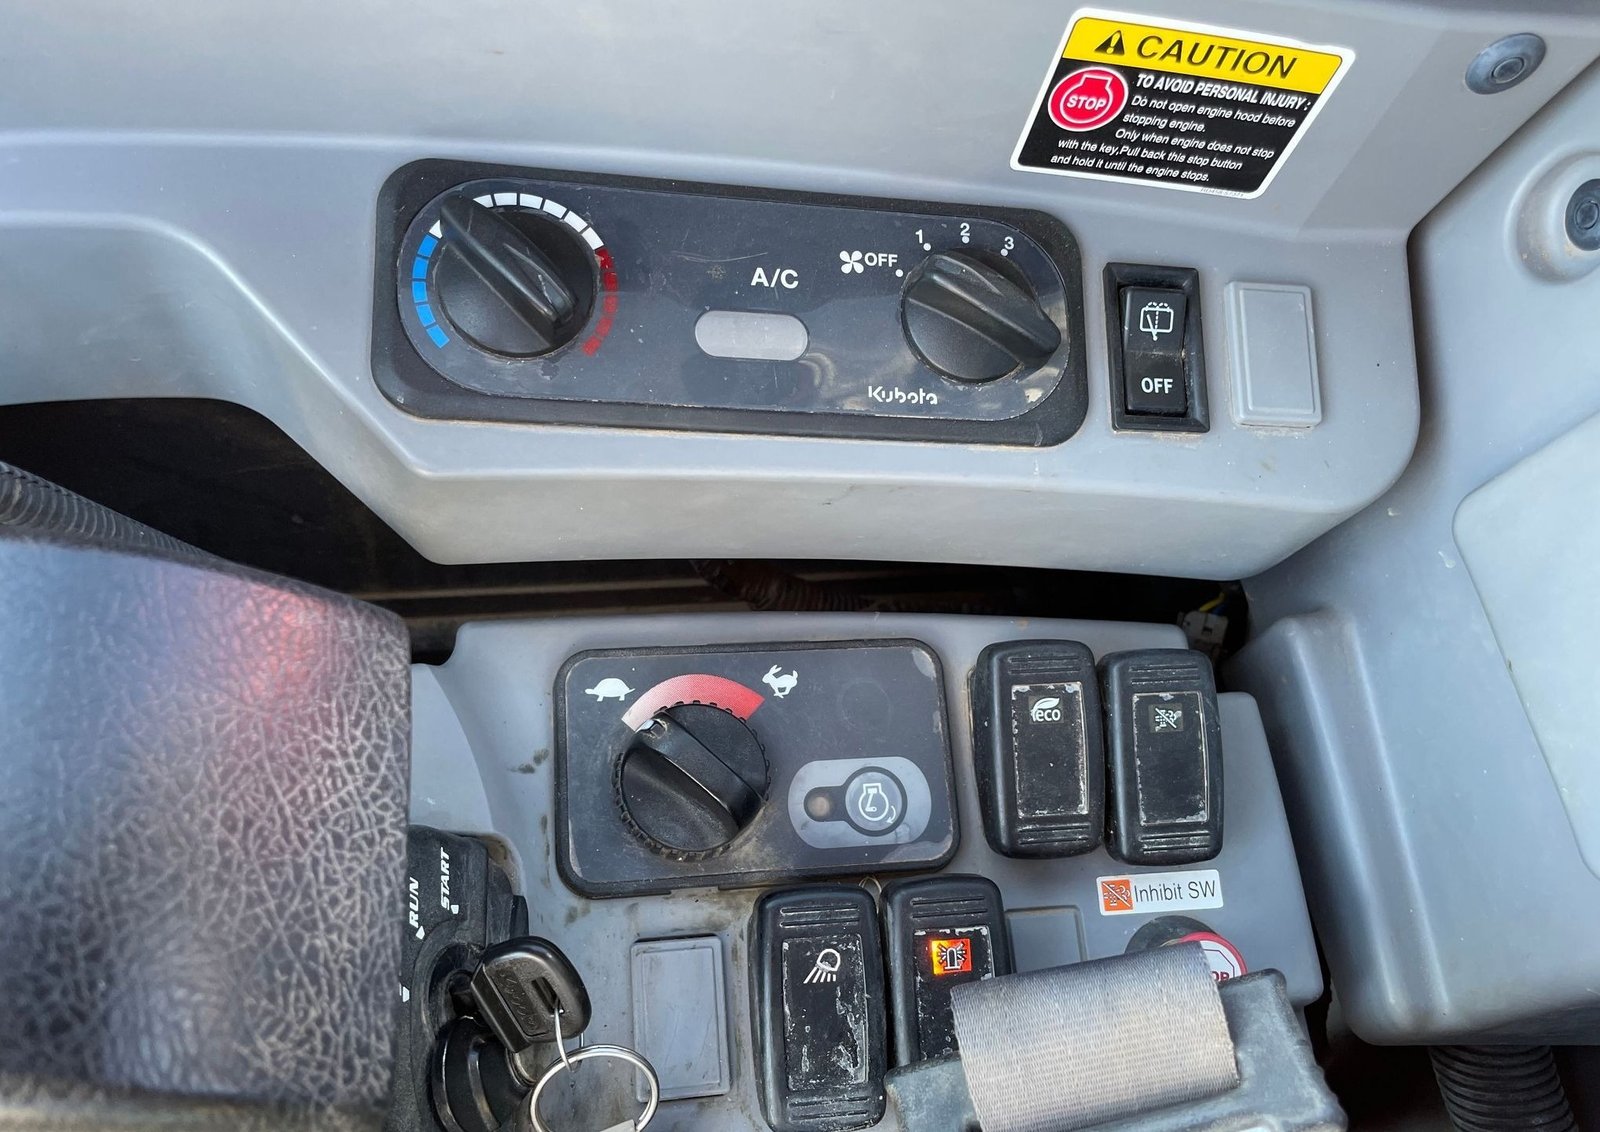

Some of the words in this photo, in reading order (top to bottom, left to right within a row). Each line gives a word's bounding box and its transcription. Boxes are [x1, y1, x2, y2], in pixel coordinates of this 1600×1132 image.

[1136, 35, 1298, 79] CAUTION
[1136, 73, 1154, 89] TO
[1154, 78, 1194, 94] AVOID
[1194, 82, 1258, 104] PERSONAL
[1066, 95, 1107, 112] STOP
[1131, 95, 1147, 107] Do
[1149, 98, 1167, 110] not
[1168, 102, 1196, 114] open
[1197, 105, 1232, 120] engine
[1233, 109, 1261, 123] hood
[1263, 113, 1296, 128] before
[1123, 113, 1168, 130] stopping
[1169, 120, 1206, 133] engine.
[1057, 139, 1080, 150] with
[1080, 141, 1097, 152] the
[1140, 148, 1166, 160] back
[1166, 151, 1185, 163] this
[1186, 156, 1210, 168] stop
[1210, 157, 1243, 171] button
[1115, 128, 1140, 142] Only
[1142, 132, 1169, 144] when
[1170, 136, 1205, 150] engine
[1206, 141, 1233, 153] does
[1233, 145, 1251, 156] not
[1251, 148, 1274, 160] stop
[1050, 154, 1072, 164] and
[1072, 156, 1095, 167] hold
[1095, 158, 1104, 169] it
[1104, 160, 1127, 172] until
[1127, 163, 1144, 174] the
[1145, 165, 1180, 179] engine
[1180, 169, 1210, 182] stops.
[915, 229, 924, 244] 1
[960, 222, 971, 237] 2
[1004, 236, 1015, 251] 3
[864, 252, 899, 268] OFF
[750, 267, 799, 289] A/C
[868, 385, 938, 405] Kubota
[1141, 377, 1174, 394] OFF
[440, 846, 450, 911] START
[409, 876, 419, 928] RUN
[1134, 883, 1183, 902] Inhibit
[1188, 880, 1217, 899] SW
